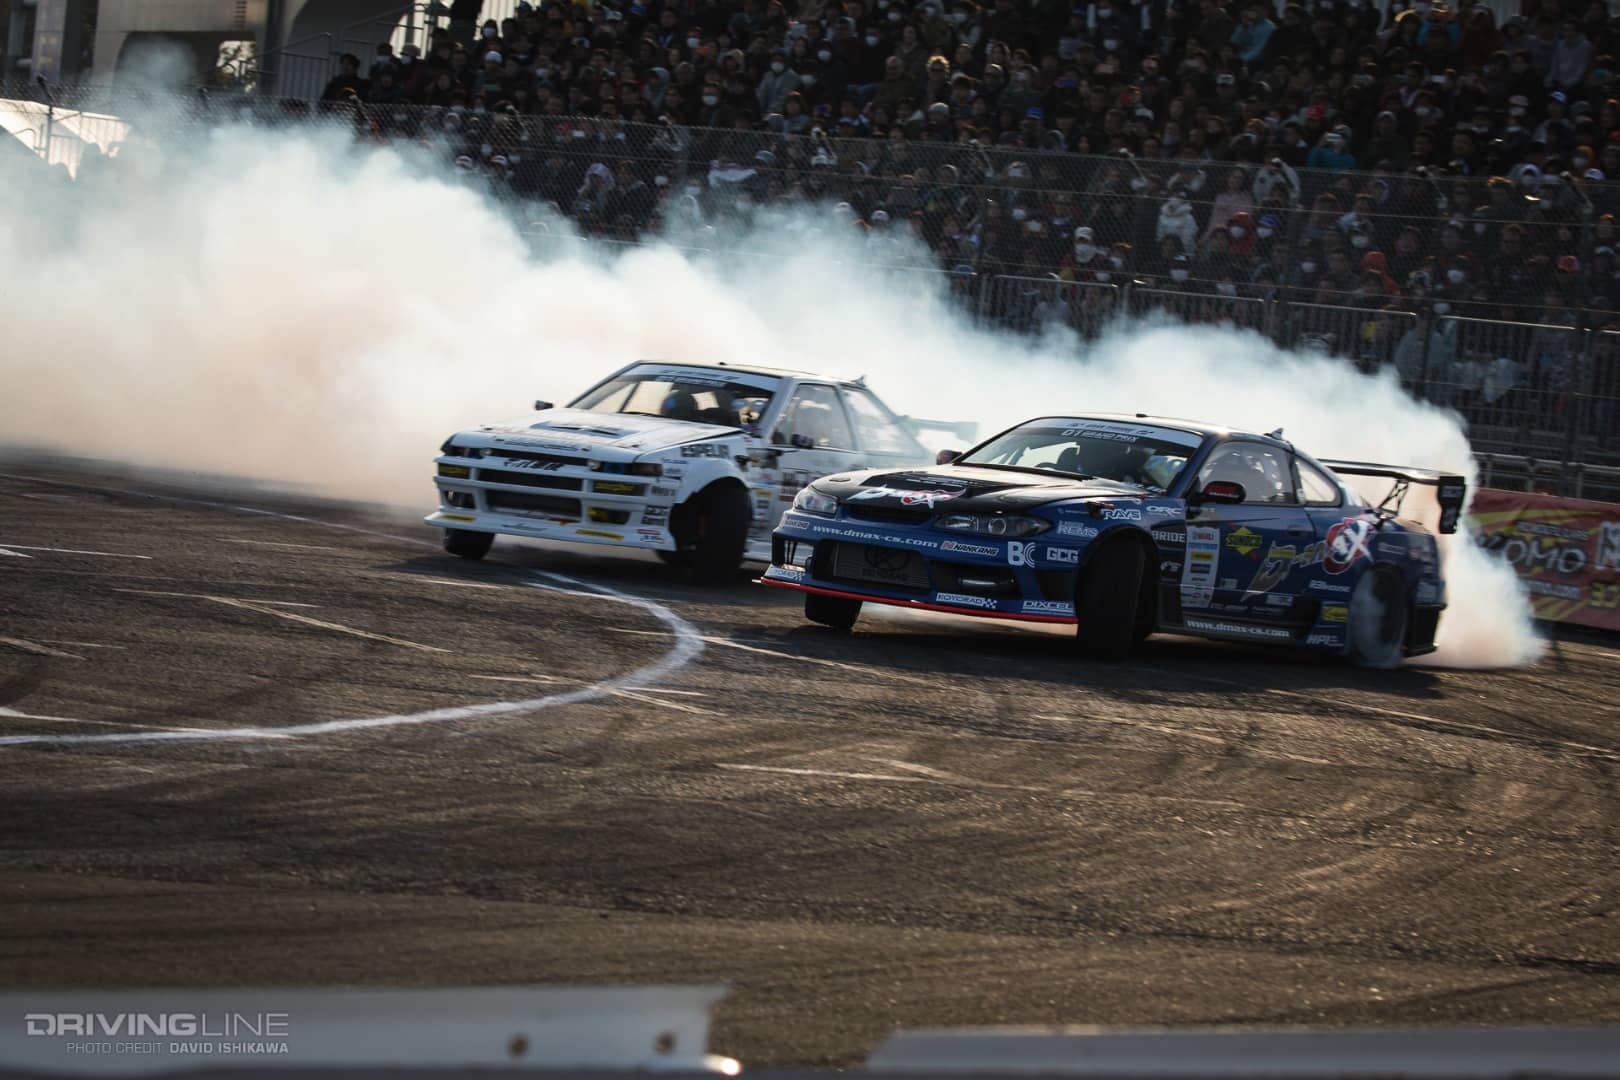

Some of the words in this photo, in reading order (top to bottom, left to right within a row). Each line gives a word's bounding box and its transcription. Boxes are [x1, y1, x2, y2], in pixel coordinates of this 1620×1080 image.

[1102, 508, 1141, 520] RAYS
[1146, 505, 1182, 517] ORC
[813, 524, 938, 548] www.dmax-cs.com
[1151, 530, 1185, 543] BRIDE
[953, 542, 999, 556] NANKANG
[1047, 548, 1079, 563] GCG
[1022, 600, 1074, 610] DIXCEL
[1187, 619, 1290, 637] www.dmax-cs.com
